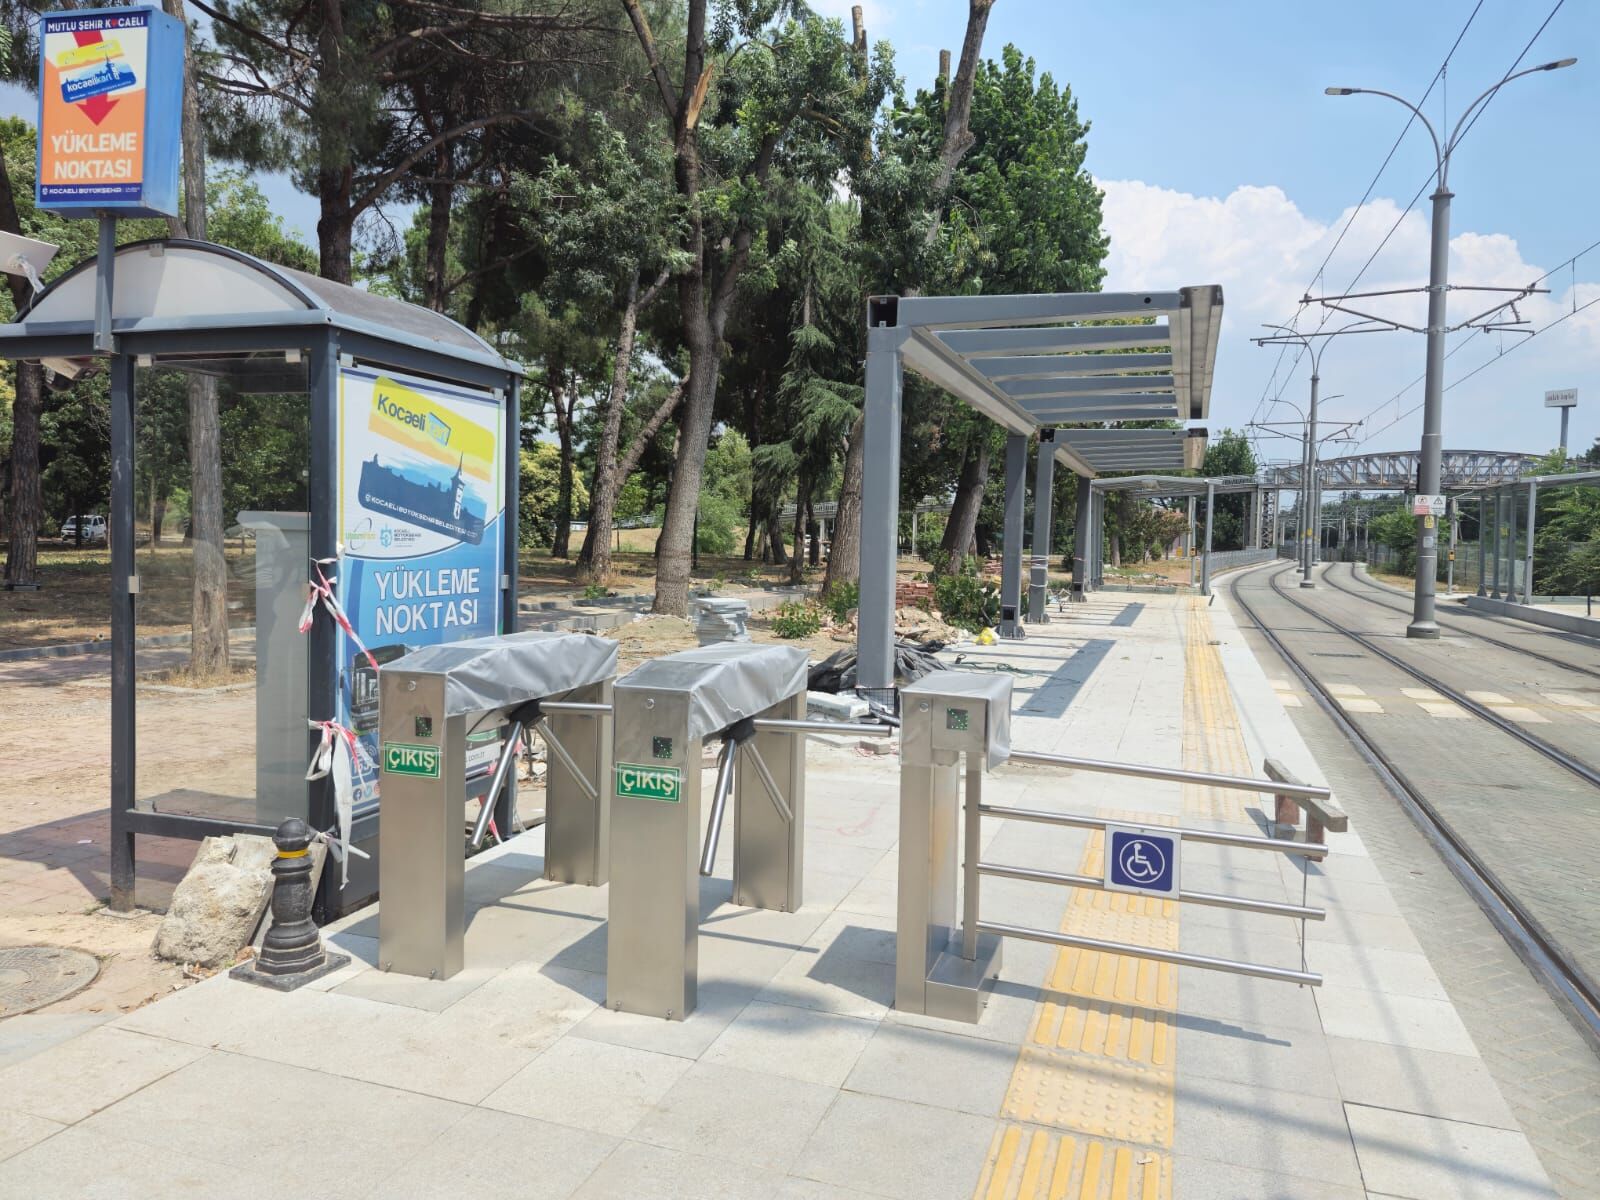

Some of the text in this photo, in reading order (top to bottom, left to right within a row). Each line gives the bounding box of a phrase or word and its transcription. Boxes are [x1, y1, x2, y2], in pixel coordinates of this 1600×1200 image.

[48, 21, 76, 32] MUTLU
[51, 129, 137, 154] YÜKLEME
[54, 158, 132, 179] NOKTASI
[377, 393, 427, 431] Kocaeli
[374, 565, 480, 600] YÜKLEME
[376, 599, 478, 636] NOKTASI
[389, 748, 435, 771] ÇIKIŞ
[622, 769, 675, 795] ÇIKIŞ
